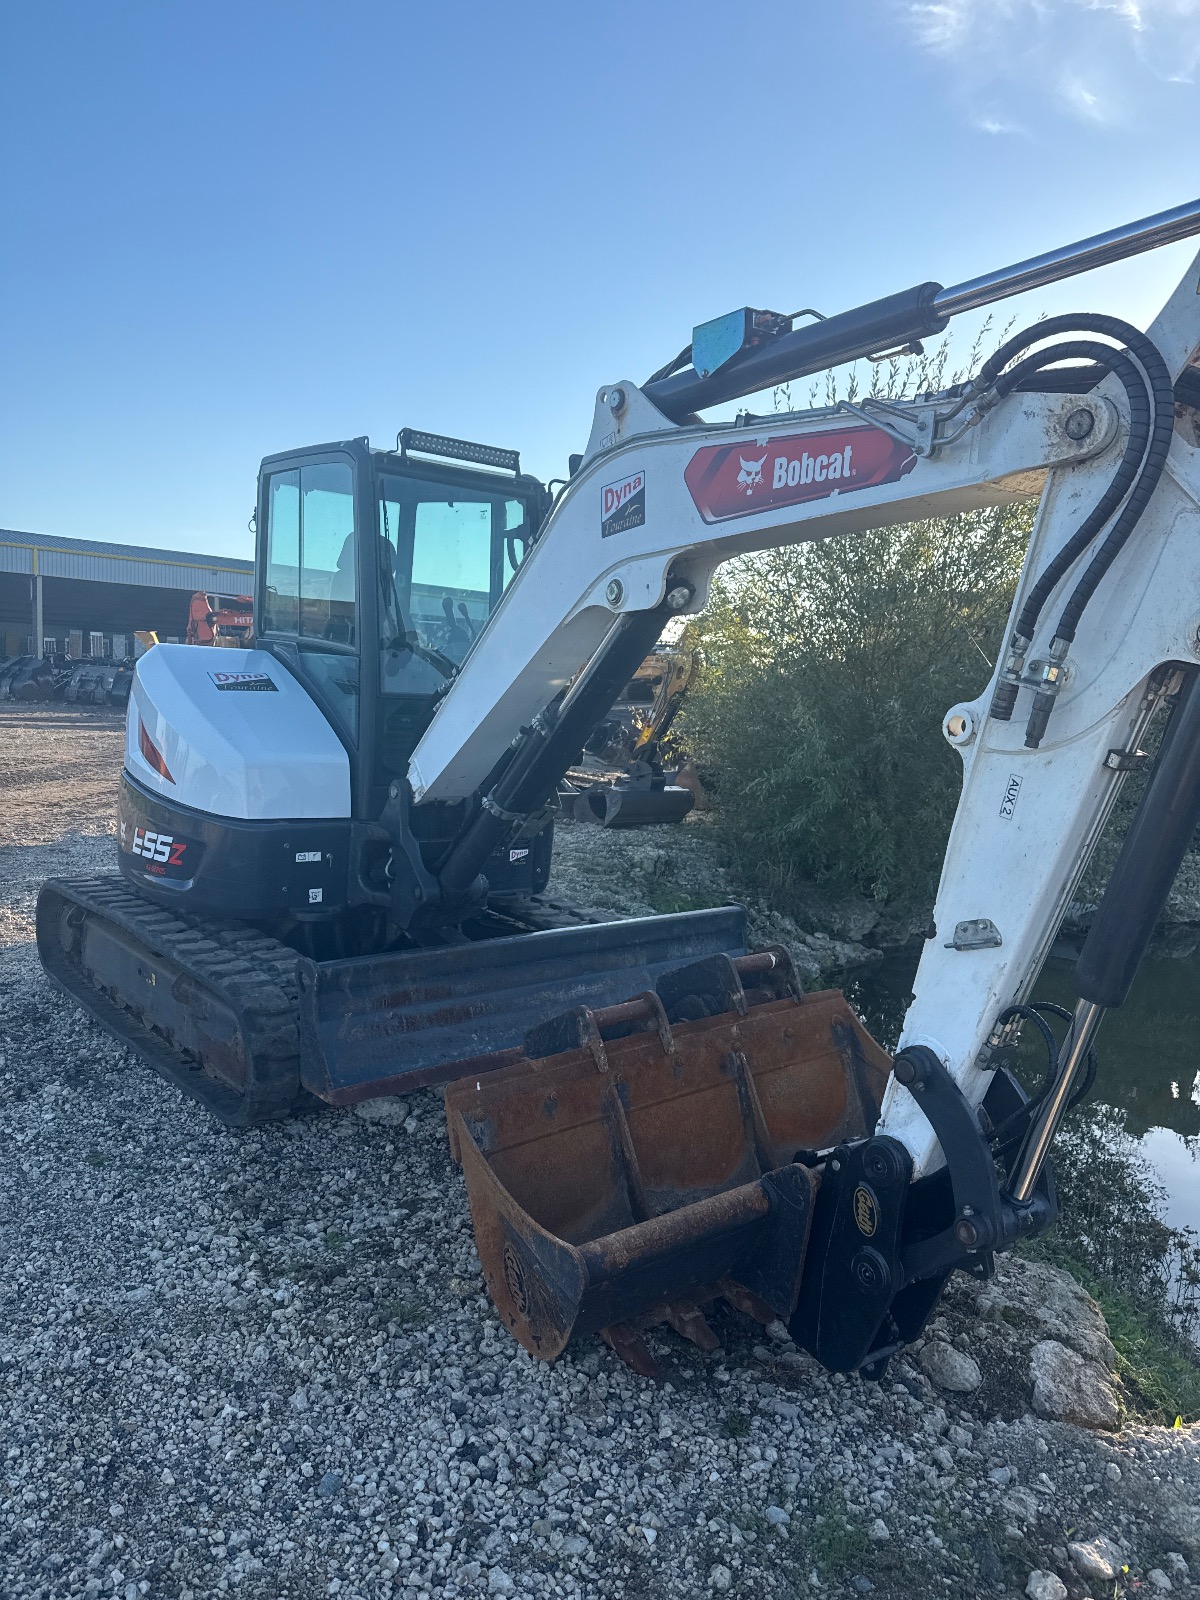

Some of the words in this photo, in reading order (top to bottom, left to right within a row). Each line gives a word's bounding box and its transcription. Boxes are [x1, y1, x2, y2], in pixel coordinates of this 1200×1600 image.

[773, 445, 853, 489] Bobcat
[604, 476, 642, 514] Dyna
[604, 513, 643, 535] Touraine
[213, 672, 265, 683] Dyna
[1004, 778, 1020, 806] AUX
[1002, 806, 1012, 815] 2
